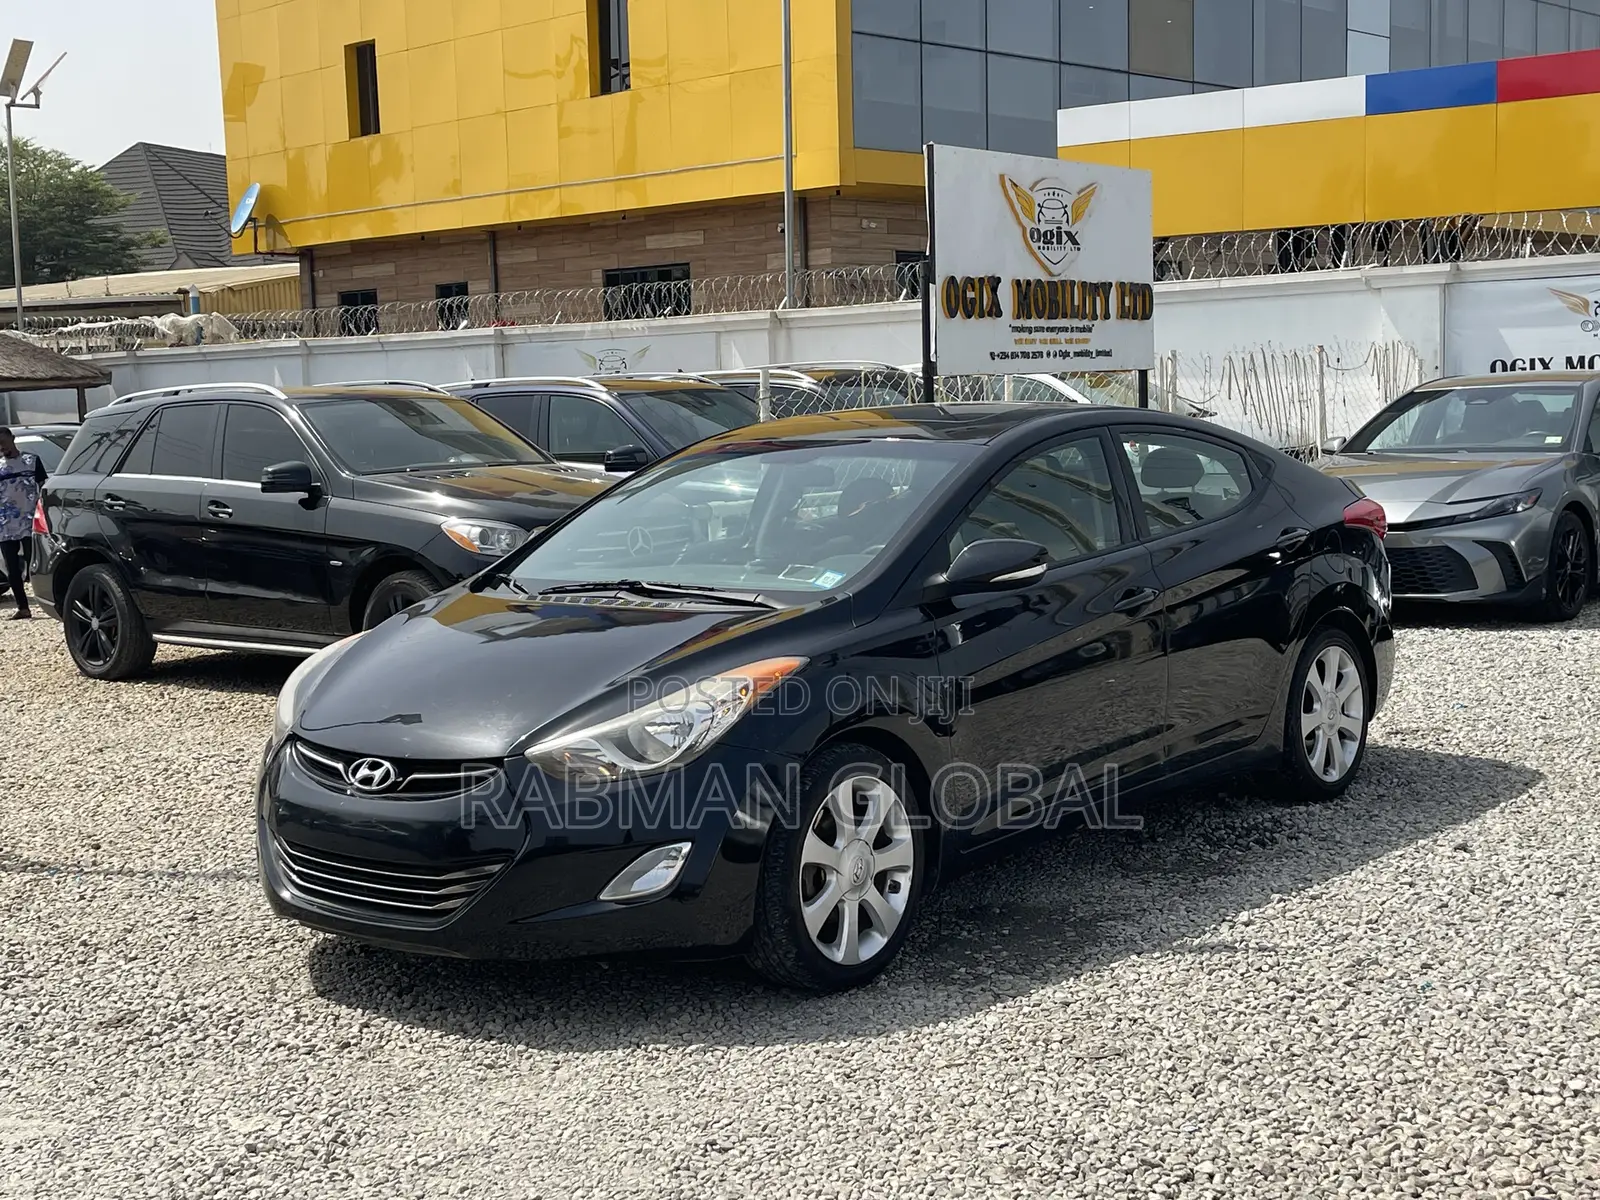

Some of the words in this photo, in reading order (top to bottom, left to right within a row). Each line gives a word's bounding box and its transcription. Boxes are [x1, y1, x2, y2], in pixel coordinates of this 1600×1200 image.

[941, 275, 1003, 320] OGIX
[1011, 278, 1113, 321] MOBILITY
[1115, 281, 1154, 321] LTD
[1033, 325, 1045, 333] sure
[1045, 325, 1070, 335] everyone
[1070, 325, 1075, 333] is
